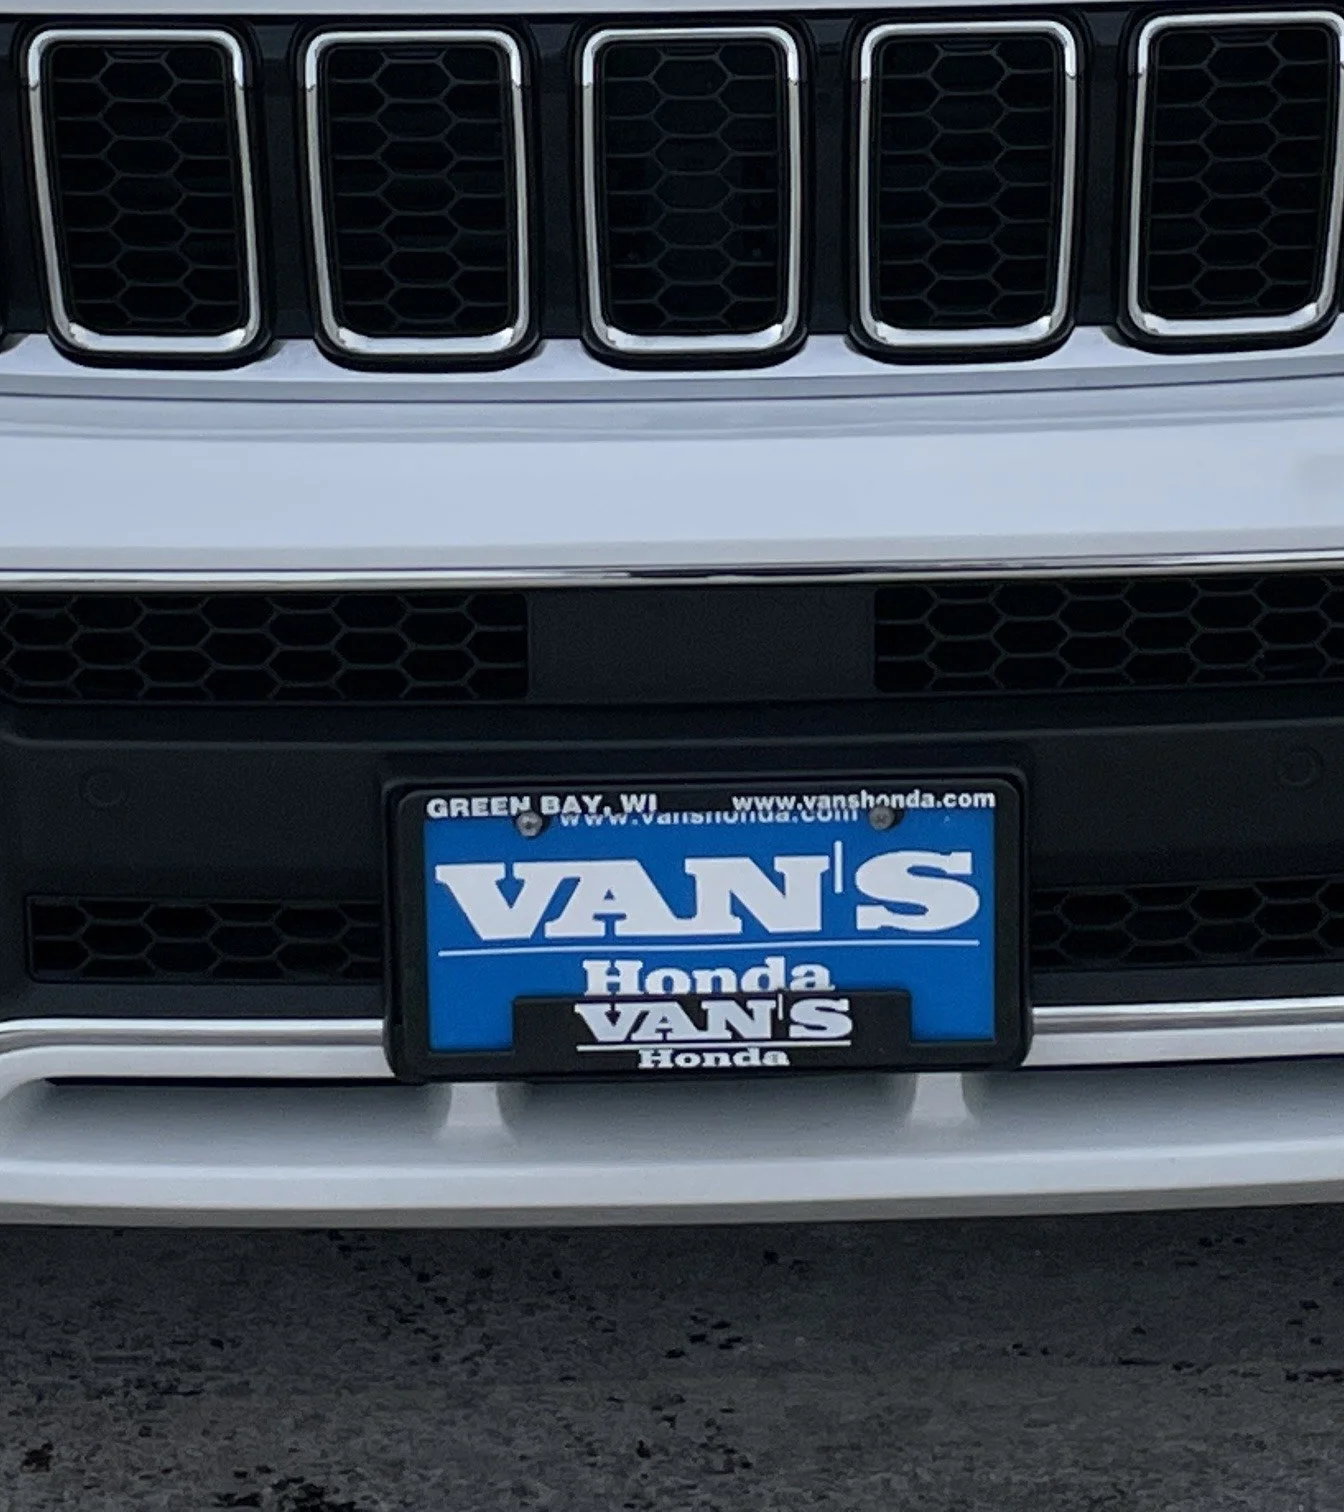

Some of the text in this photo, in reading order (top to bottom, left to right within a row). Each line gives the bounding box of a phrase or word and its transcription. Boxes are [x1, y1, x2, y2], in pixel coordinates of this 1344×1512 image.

[427, 793, 658, 819] GREEN BAY, WI
[732, 789, 996, 811] www.vanshonda.com
[435, 840, 981, 941] VAN'S
[581, 956, 836, 996] Honda
[573, 992, 854, 1042] VAN'S
[636, 1047, 791, 1069] Honda
